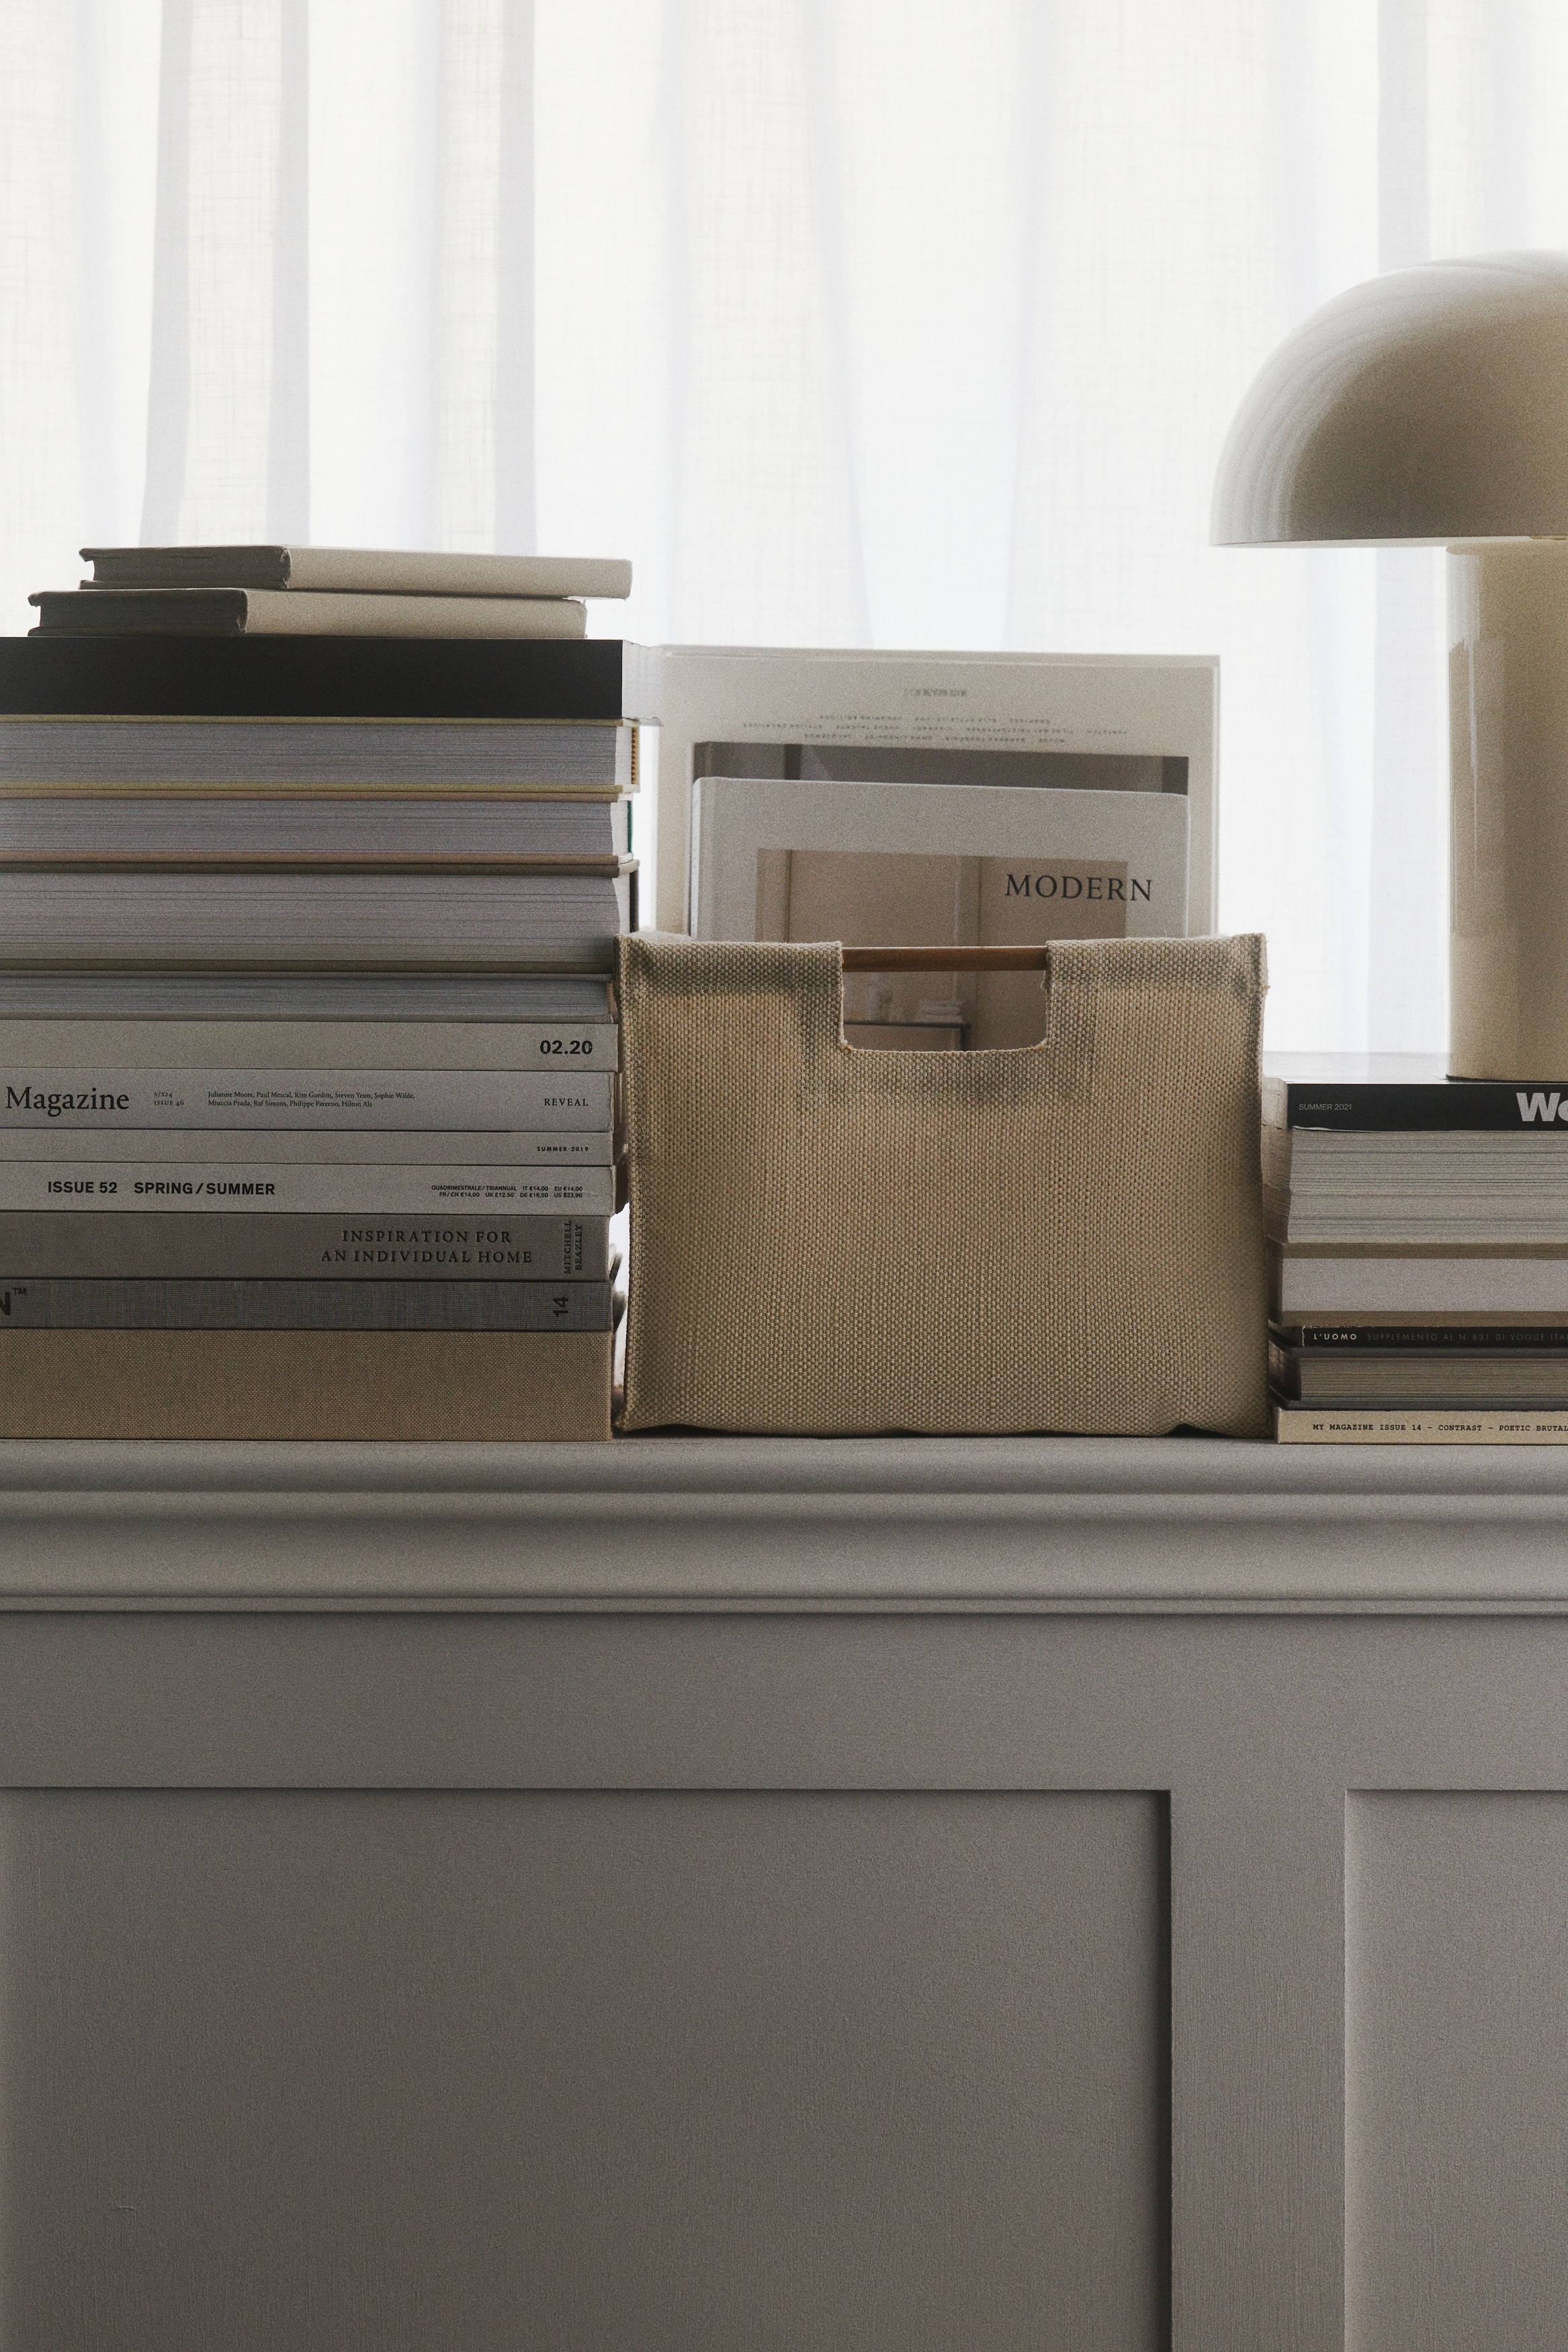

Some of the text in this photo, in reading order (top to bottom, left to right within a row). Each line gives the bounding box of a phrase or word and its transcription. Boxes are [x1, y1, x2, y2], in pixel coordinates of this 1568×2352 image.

[1004, 874, 1153, 902] MODERN
[539, 1040, 593, 1055] 02.20
[5, 1086, 130, 1118] Magazine
[374, 1092, 394, 1100] Sophie
[396, 1092, 415, 1100] Wilde,
[543, 1098, 589, 1106] REVEAL
[290, 1100, 314, 1108] Philippe
[1298, 1103, 1352, 1111] SUMMER 2021
[48, 1181, 94, 1193] ISSUE
[99, 1181, 118, 1193] 52
[343, 1230, 511, 1243] INSPIRATION FOR
[321, 1251, 533, 1263] AN INDIVIDUAL HOME
[553, 1296, 569, 1317] 14
[1510, 1333, 1545, 1341] VOGUE
